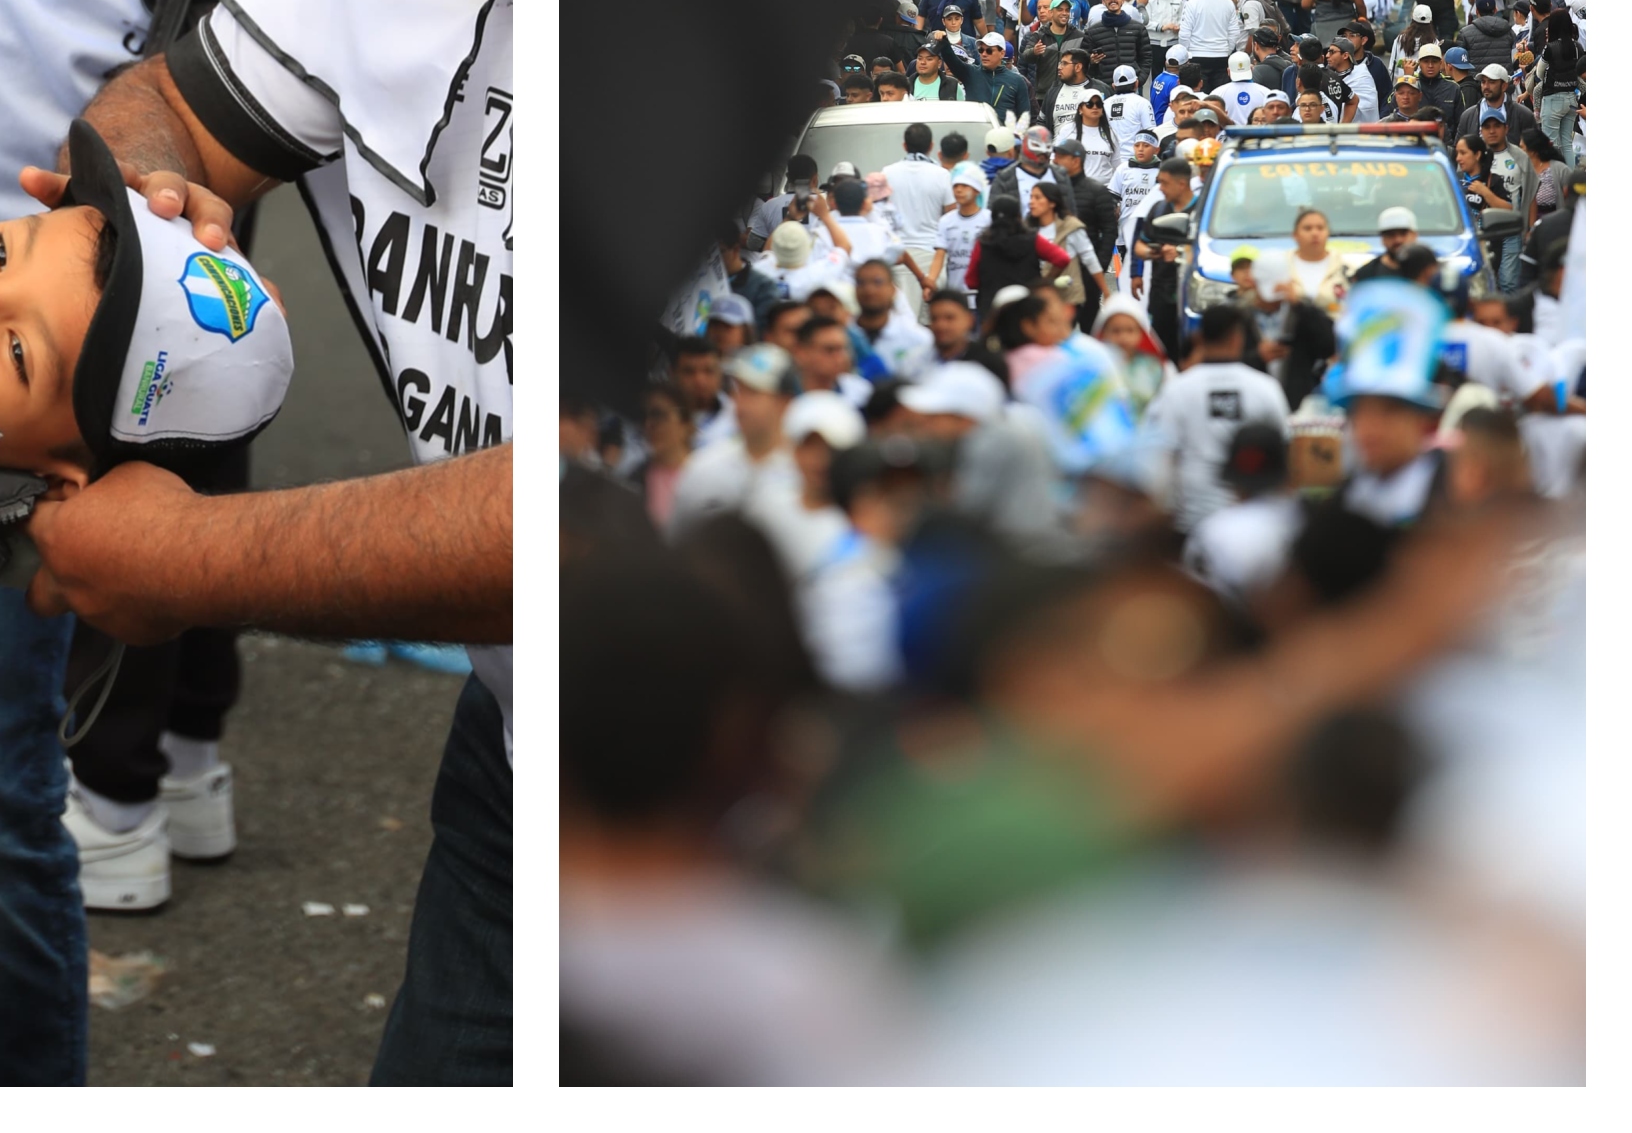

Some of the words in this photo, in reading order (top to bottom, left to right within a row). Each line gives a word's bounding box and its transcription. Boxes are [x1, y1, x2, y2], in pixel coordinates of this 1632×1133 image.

[199, 257, 244, 332] COMUNICACIONES
[152, 351, 168, 381] LIGA
[138, 383, 157, 427] GUATE
